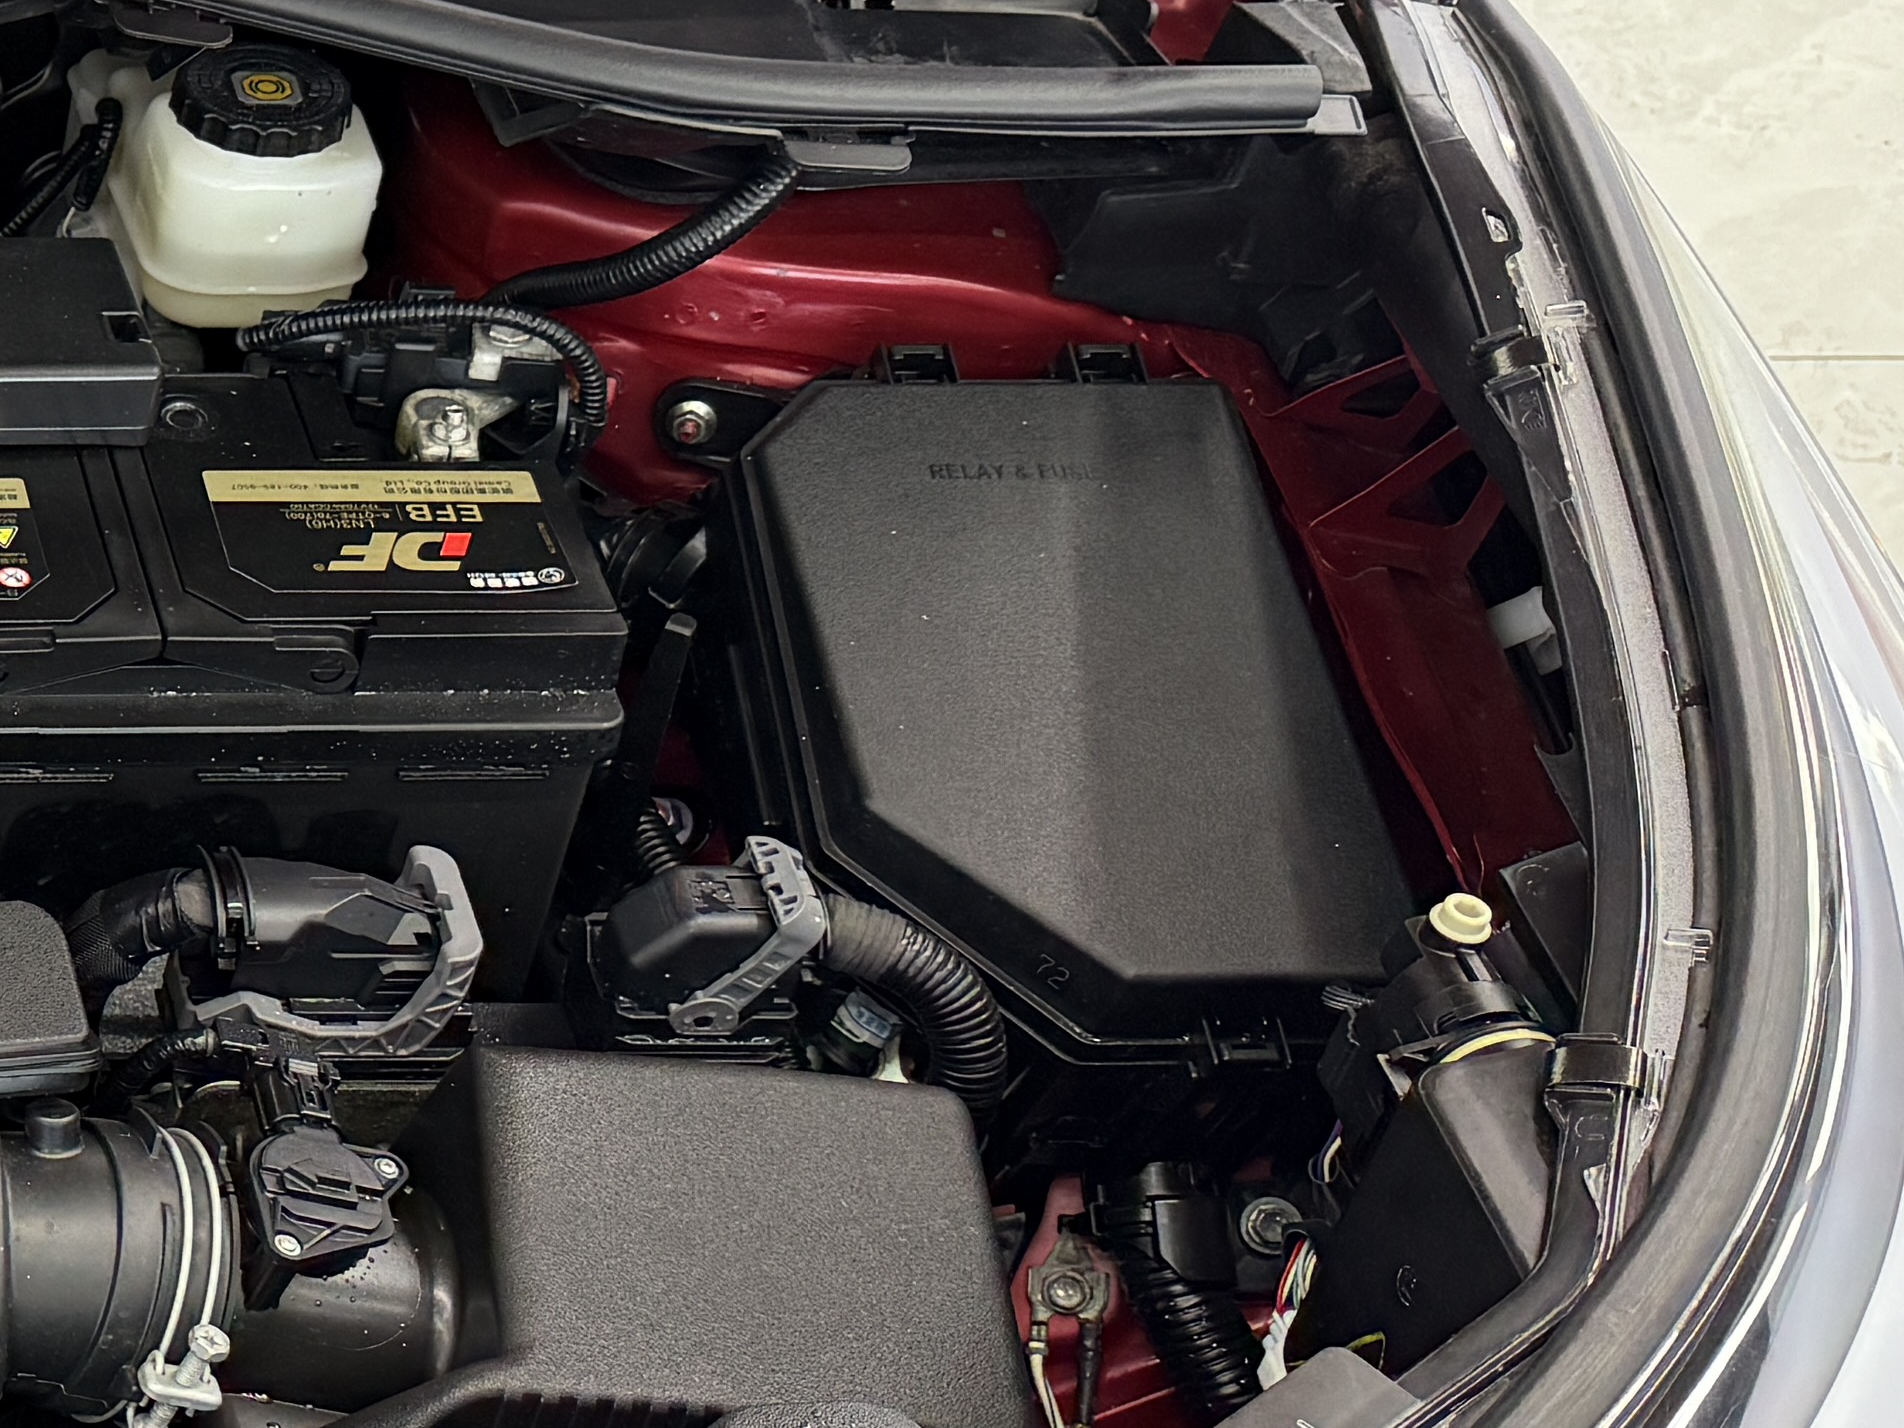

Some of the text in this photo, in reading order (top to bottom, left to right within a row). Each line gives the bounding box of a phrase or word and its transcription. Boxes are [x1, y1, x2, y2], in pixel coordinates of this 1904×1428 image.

[928, 463, 1004, 480] RELAY
[1014, 464, 1029, 479] &
[405, 503, 484, 523] EFB
[329, 531, 472, 572] DF
[1036, 953, 1070, 990] 72
